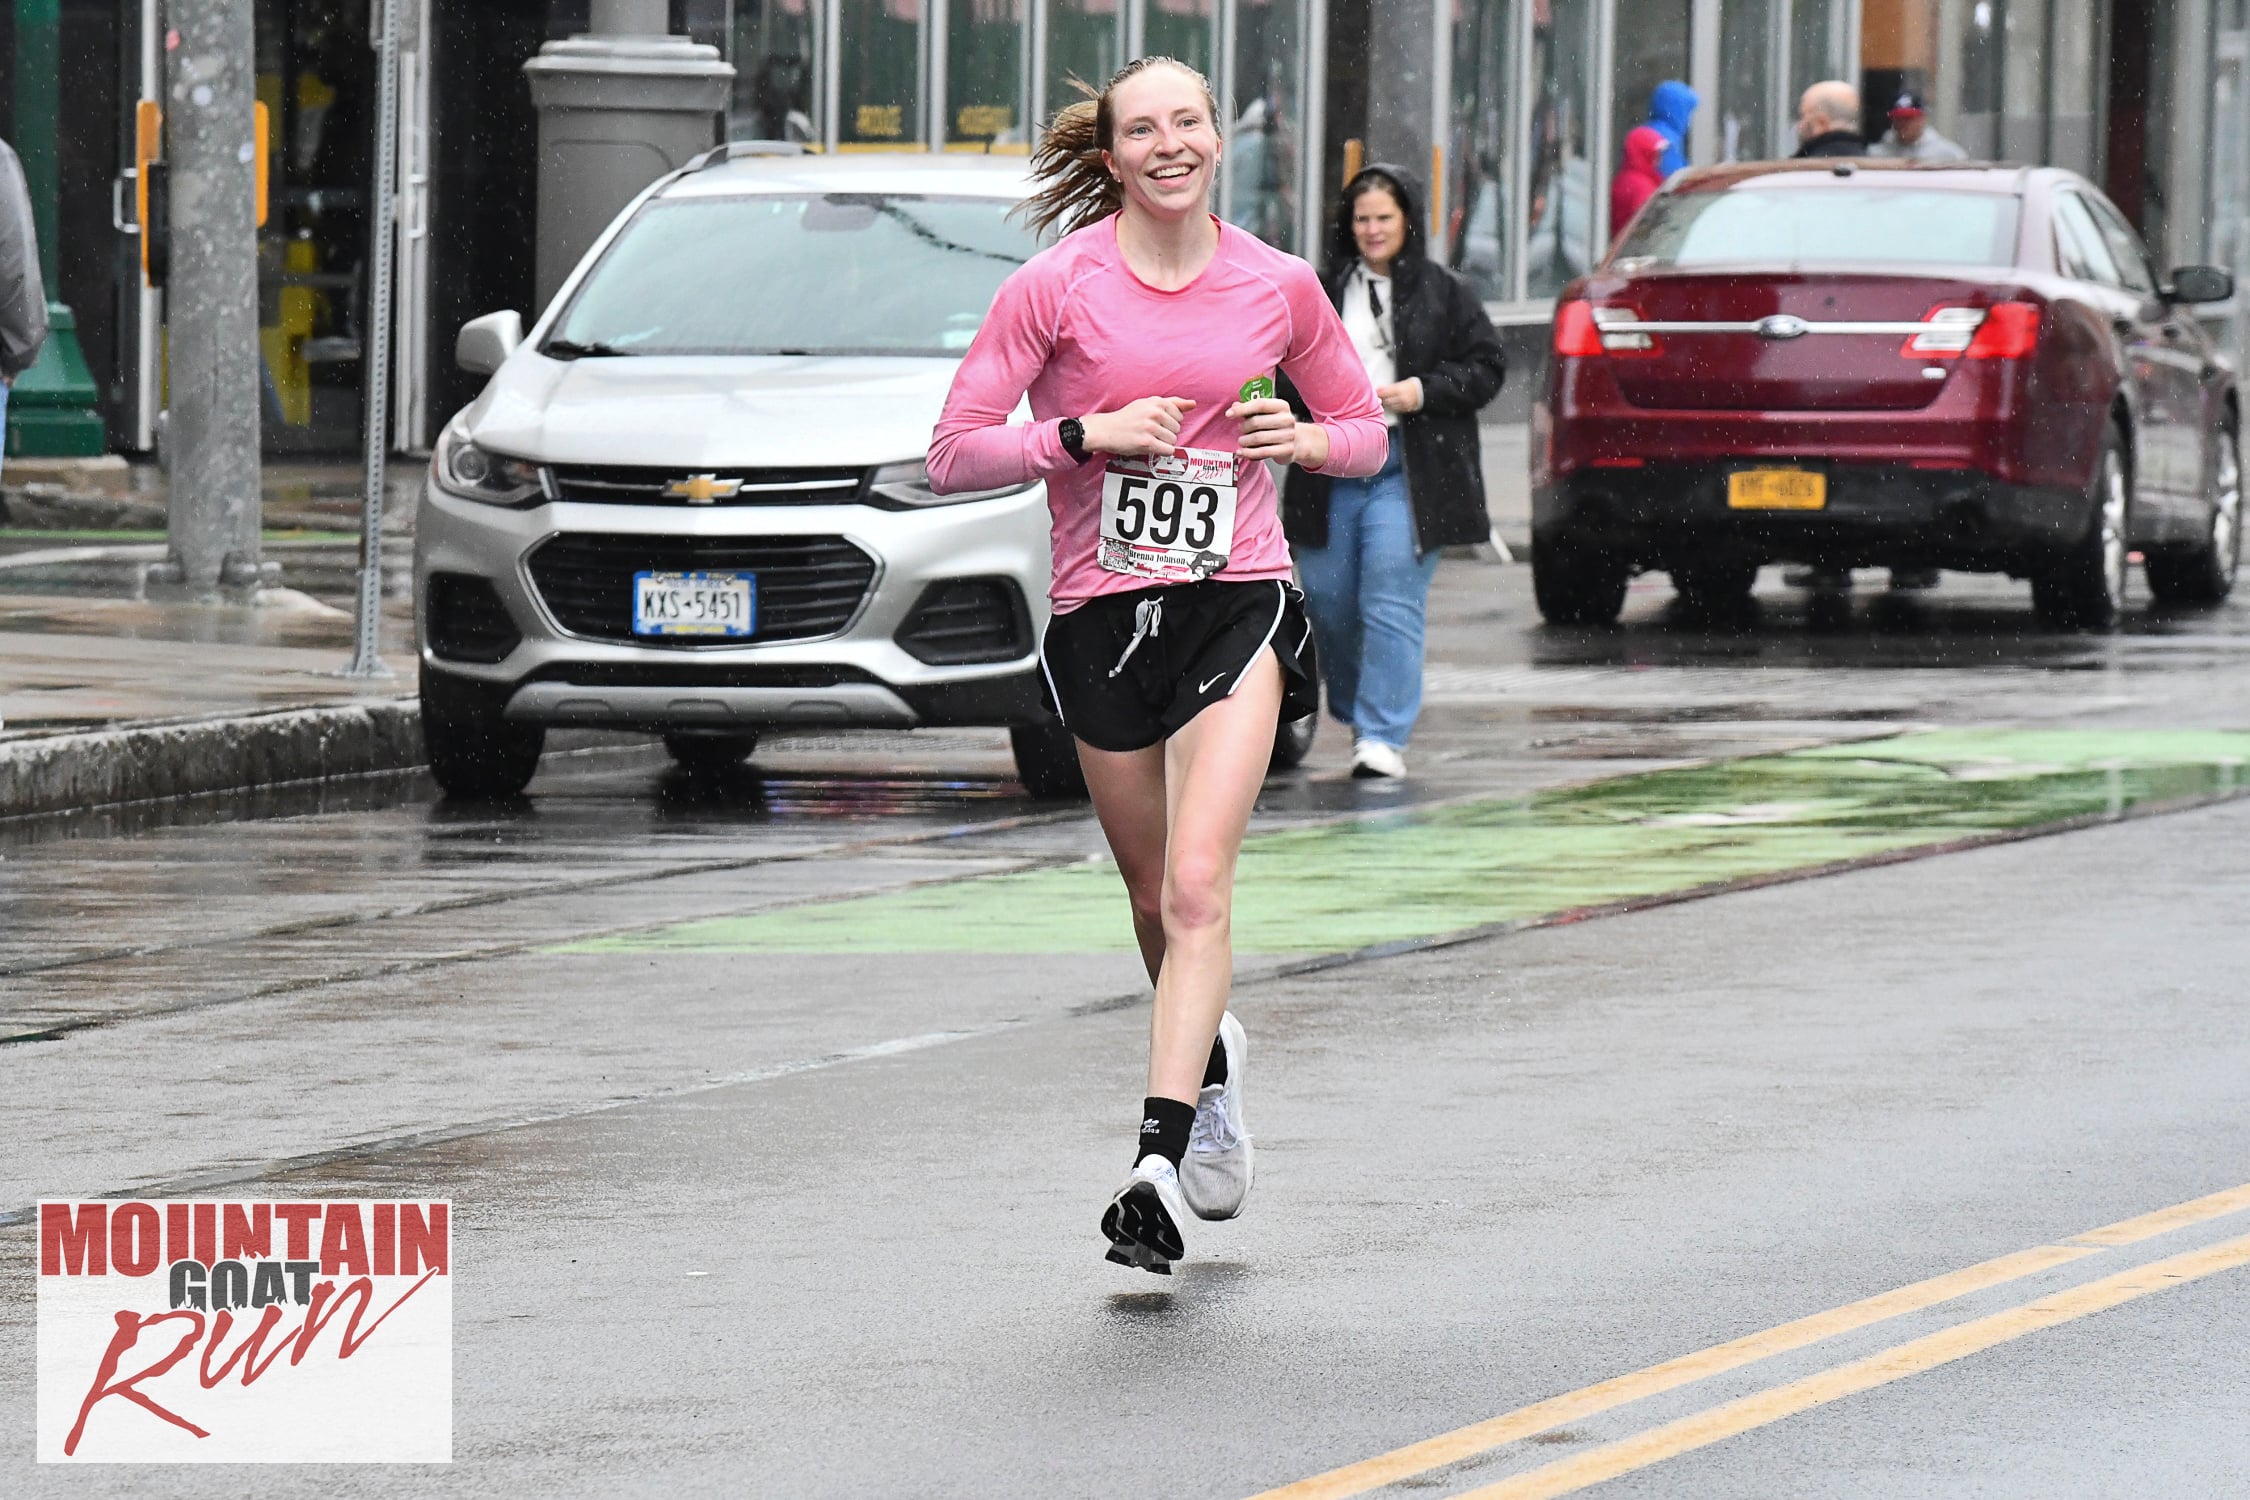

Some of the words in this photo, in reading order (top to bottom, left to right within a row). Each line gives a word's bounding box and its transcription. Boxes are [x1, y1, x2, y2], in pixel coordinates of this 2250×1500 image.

[1190, 457, 1232, 469] MOUNTAIN
[1115, 477, 1218, 549] 593
[1129, 550, 1154, 562] Brenna
[1156, 554, 1186, 565] Johnson
